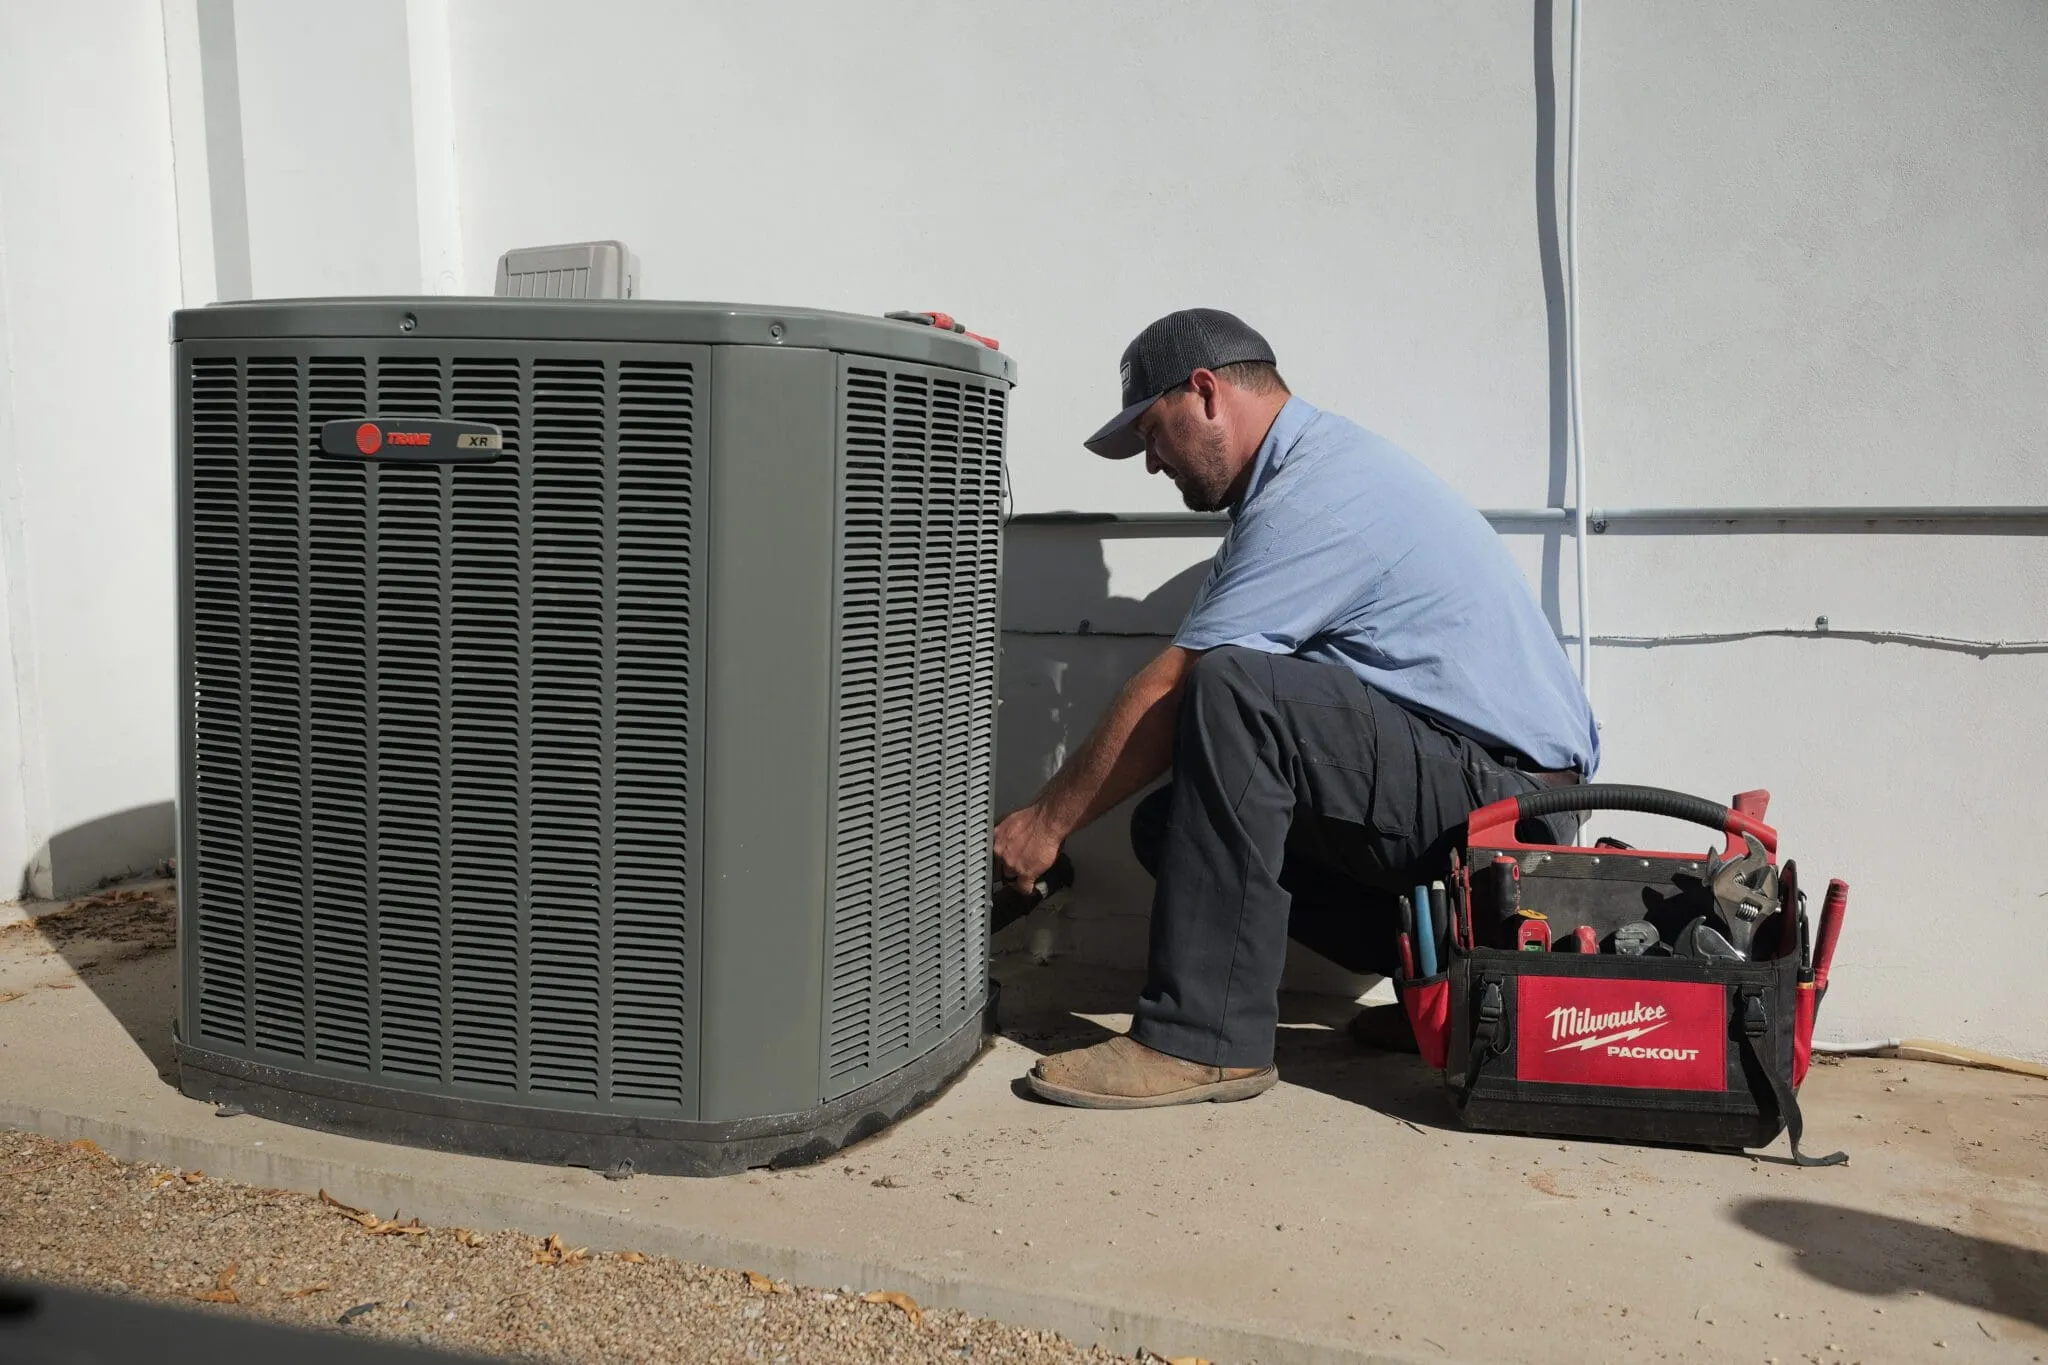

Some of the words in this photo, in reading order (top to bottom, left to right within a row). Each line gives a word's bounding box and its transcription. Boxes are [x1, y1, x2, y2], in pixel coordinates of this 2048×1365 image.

[386, 432, 432, 446] TRANE
[469, 436, 488, 446] XR
[1544, 1001, 1667, 1041] Milwaukee
[1607, 1045, 1700, 1061] PACKOUT
